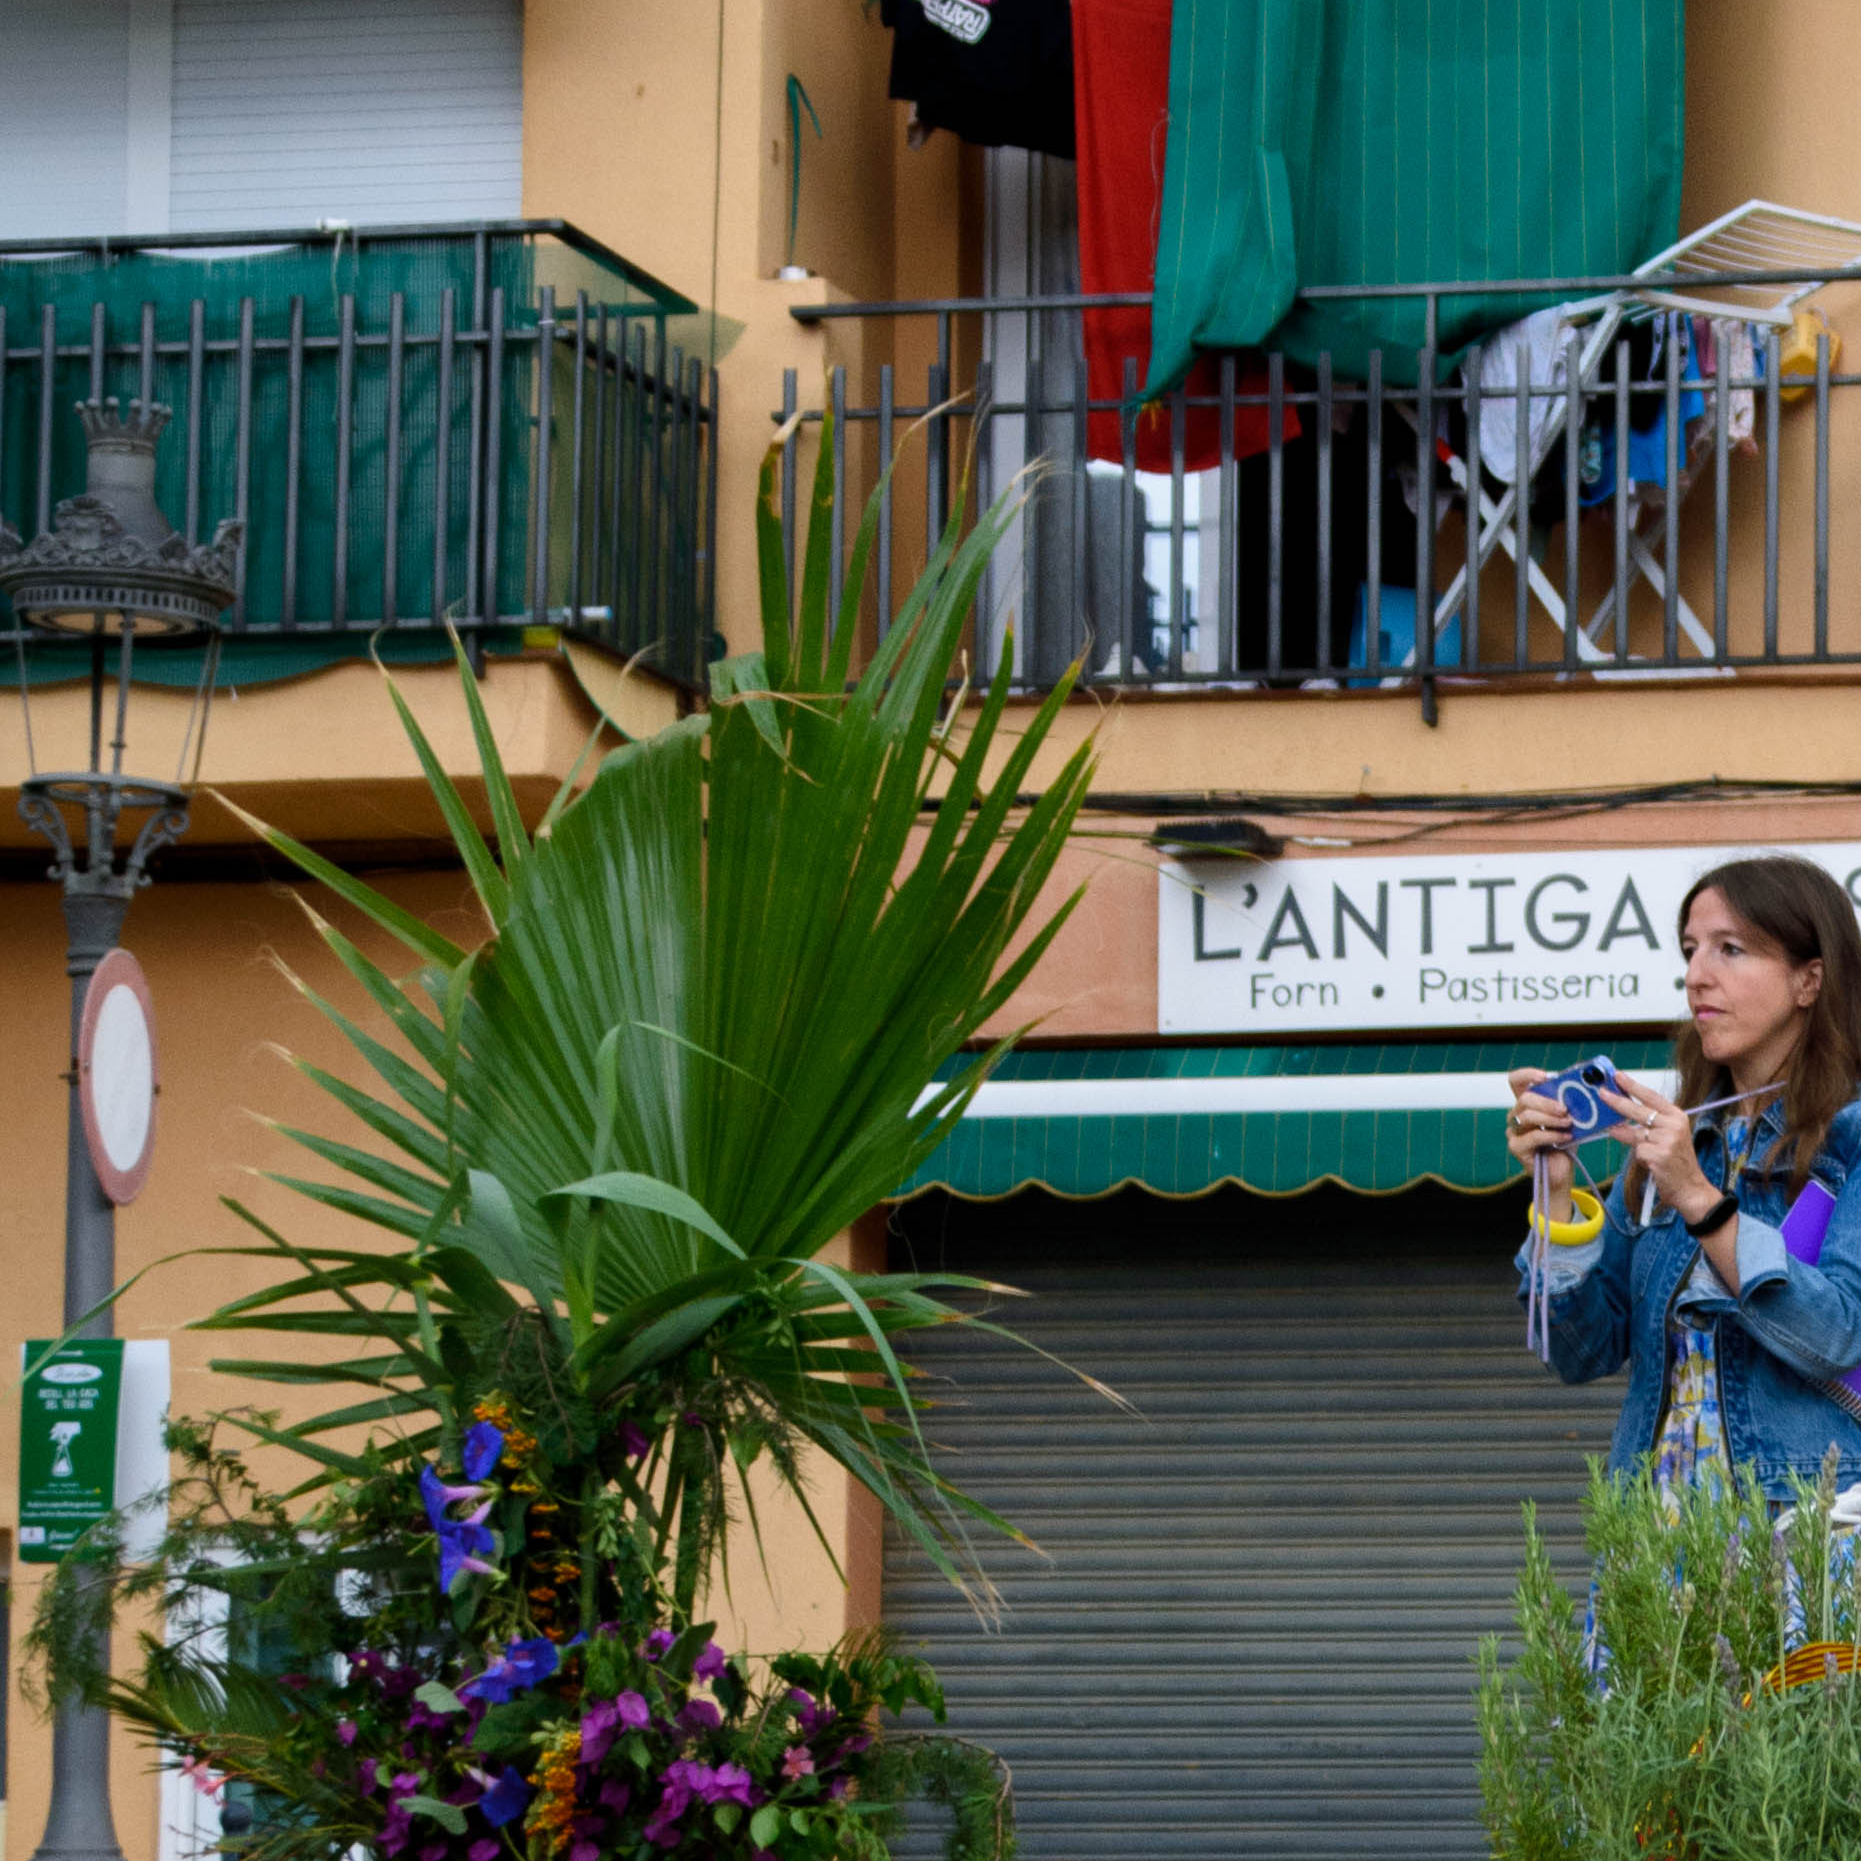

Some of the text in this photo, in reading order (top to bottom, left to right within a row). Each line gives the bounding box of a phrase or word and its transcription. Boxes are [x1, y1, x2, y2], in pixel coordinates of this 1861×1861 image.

[1192, 873, 1661, 961] L'ANTIGA
[1250, 968, 1639, 1009] Forn Pastisseria
